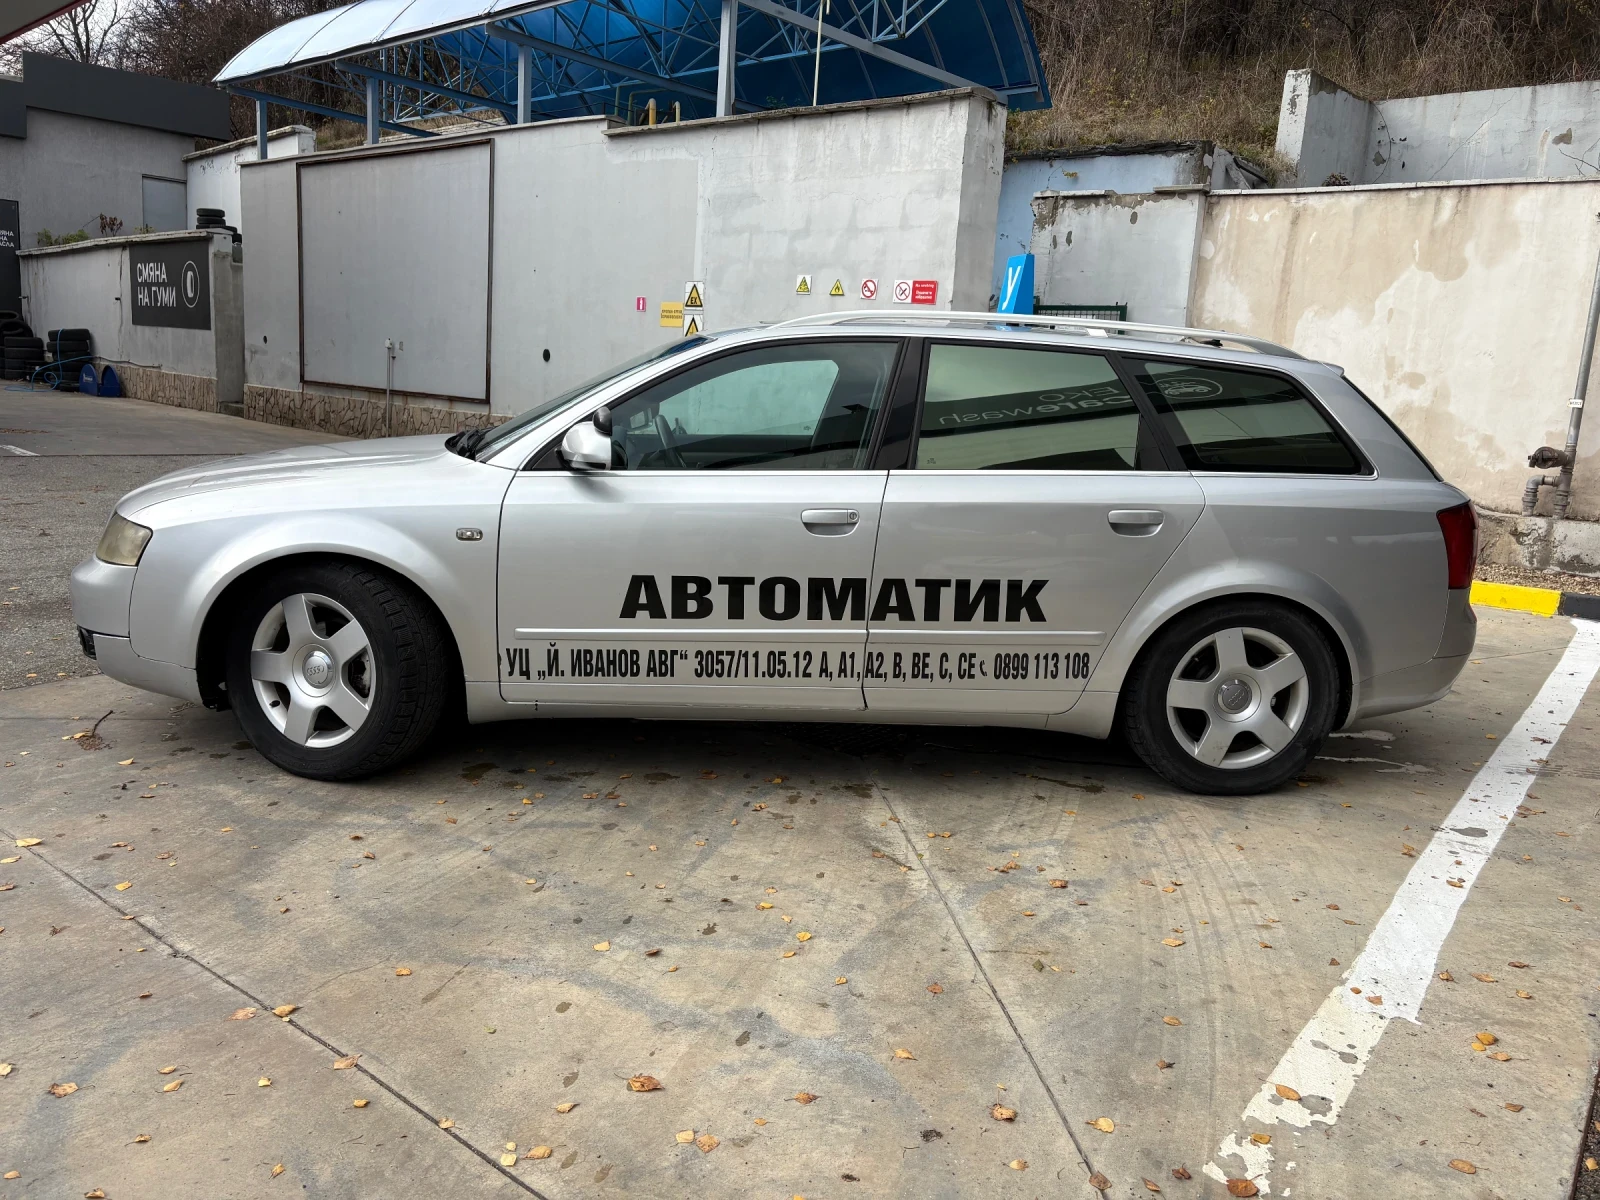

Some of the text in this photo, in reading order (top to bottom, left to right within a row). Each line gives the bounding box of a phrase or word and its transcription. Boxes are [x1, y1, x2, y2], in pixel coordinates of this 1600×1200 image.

[137, 262, 168, 283] СМЯНА
[138, 286, 176, 308] НА ГУМИ
[691, 297, 697, 305] EX
[619, 574, 1050, 623] АВТОМАТИК
[505, 647, 531, 681] УЦ
[570, 648, 641, 678] ИВАНОВ
[694, 649, 813, 679] 3057/11.05.12
[993, 652, 1029, 681] 0899
[1034, 652, 1060, 680] 113
[1064, 651, 1091, 680] 108
